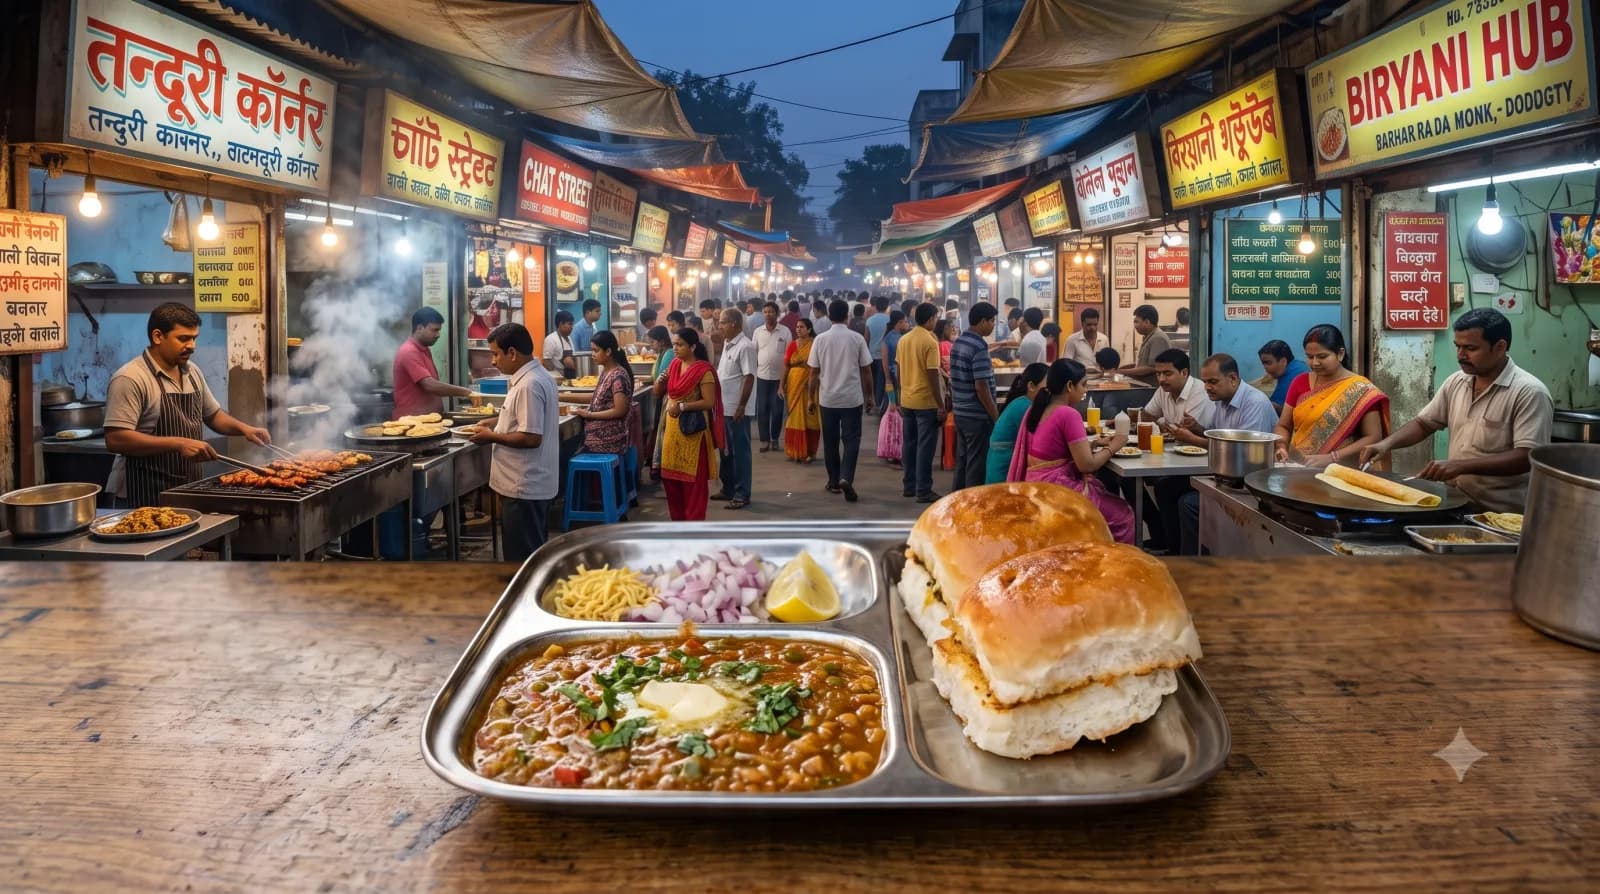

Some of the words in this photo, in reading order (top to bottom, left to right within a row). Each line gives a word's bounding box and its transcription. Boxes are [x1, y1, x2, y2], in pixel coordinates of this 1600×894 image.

[87, 16, 227, 126] तन्दूरी
[236, 65, 327, 147] कॉर्नर
[1346, 31, 1471, 126] BIRYANI
[1482, 0, 1574, 82] HUB
[88, 106, 147, 145] तन्दुरी
[524, 158, 556, 197] CHAT
[557, 171, 593, 209] STREET
